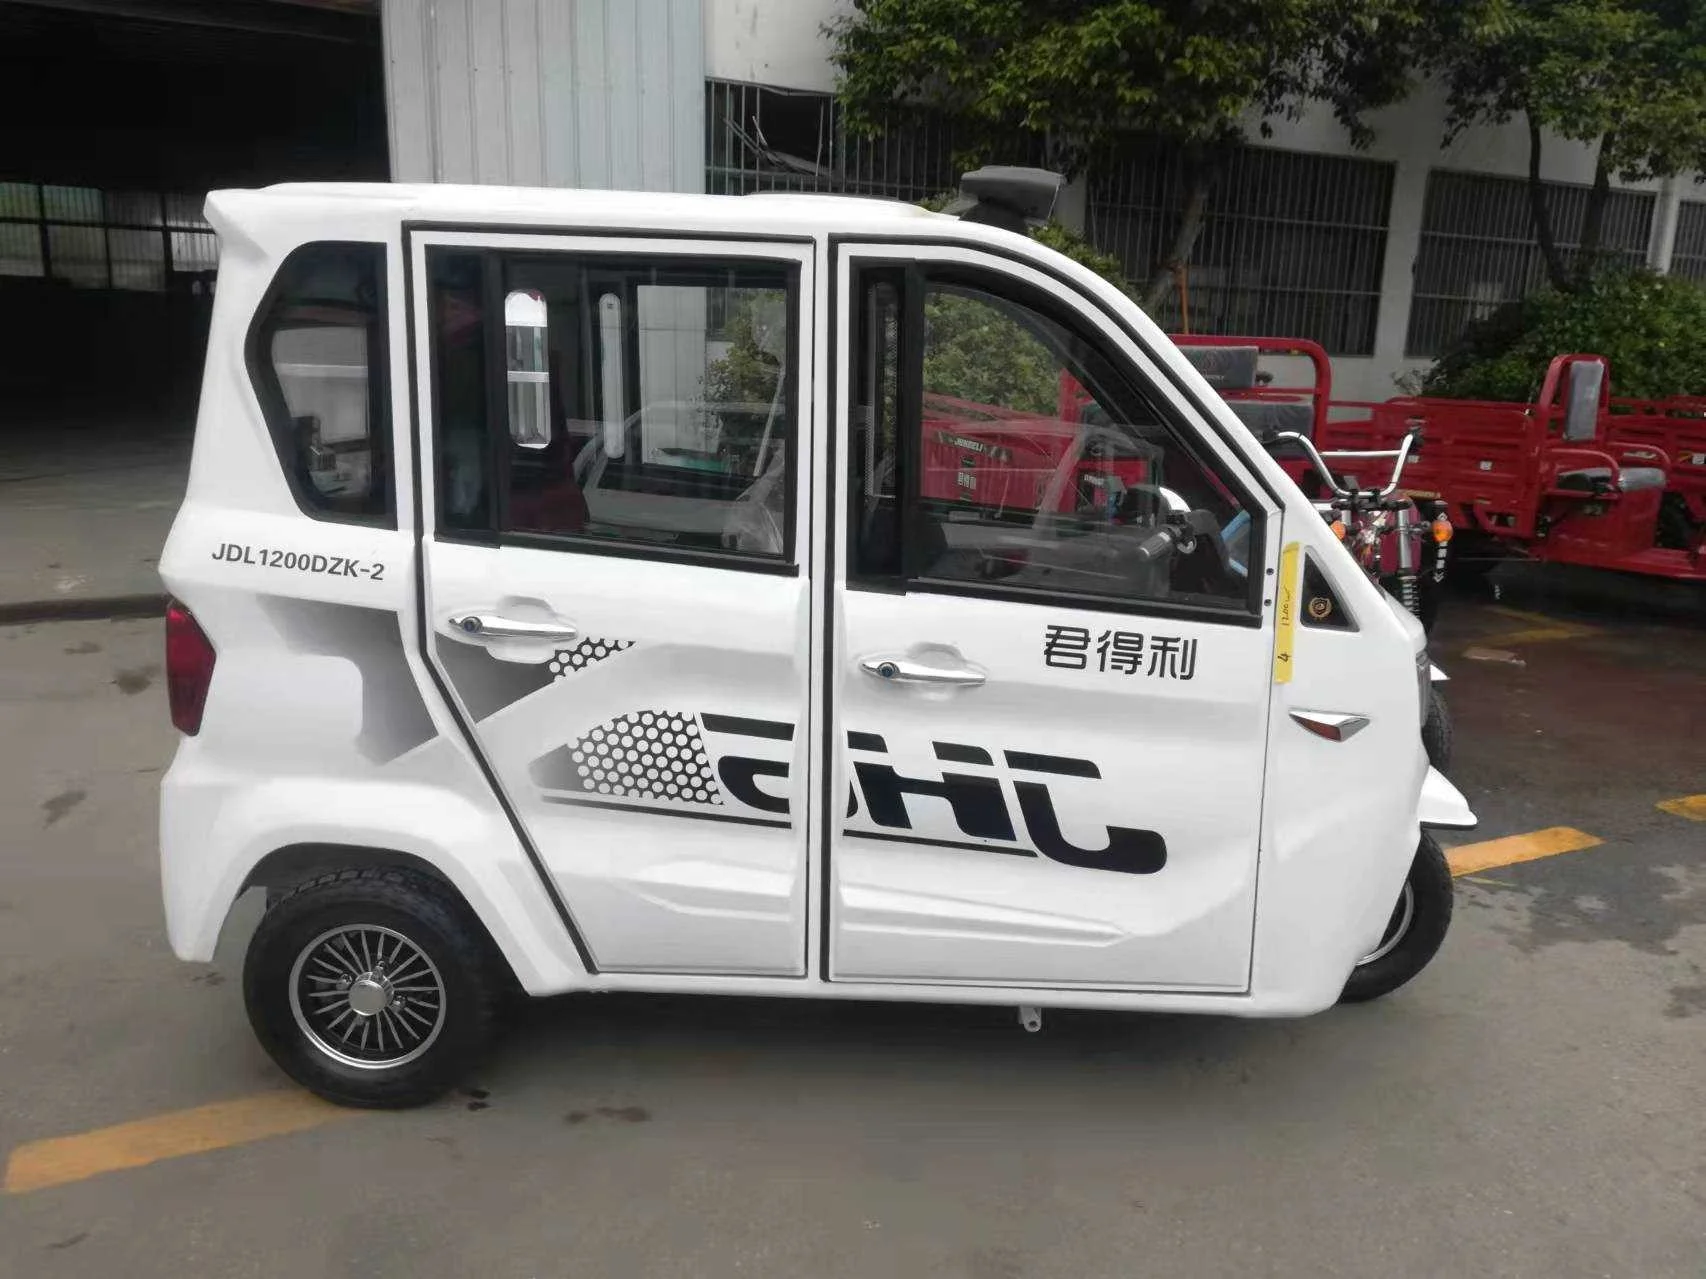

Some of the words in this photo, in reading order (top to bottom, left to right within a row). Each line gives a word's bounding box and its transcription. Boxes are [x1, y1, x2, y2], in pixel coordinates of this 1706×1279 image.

[212, 543, 385, 580] JDL1200DZK-2
[1044, 625, 1198, 680] 君得利
[1277, 651, 1292, 663] 4
